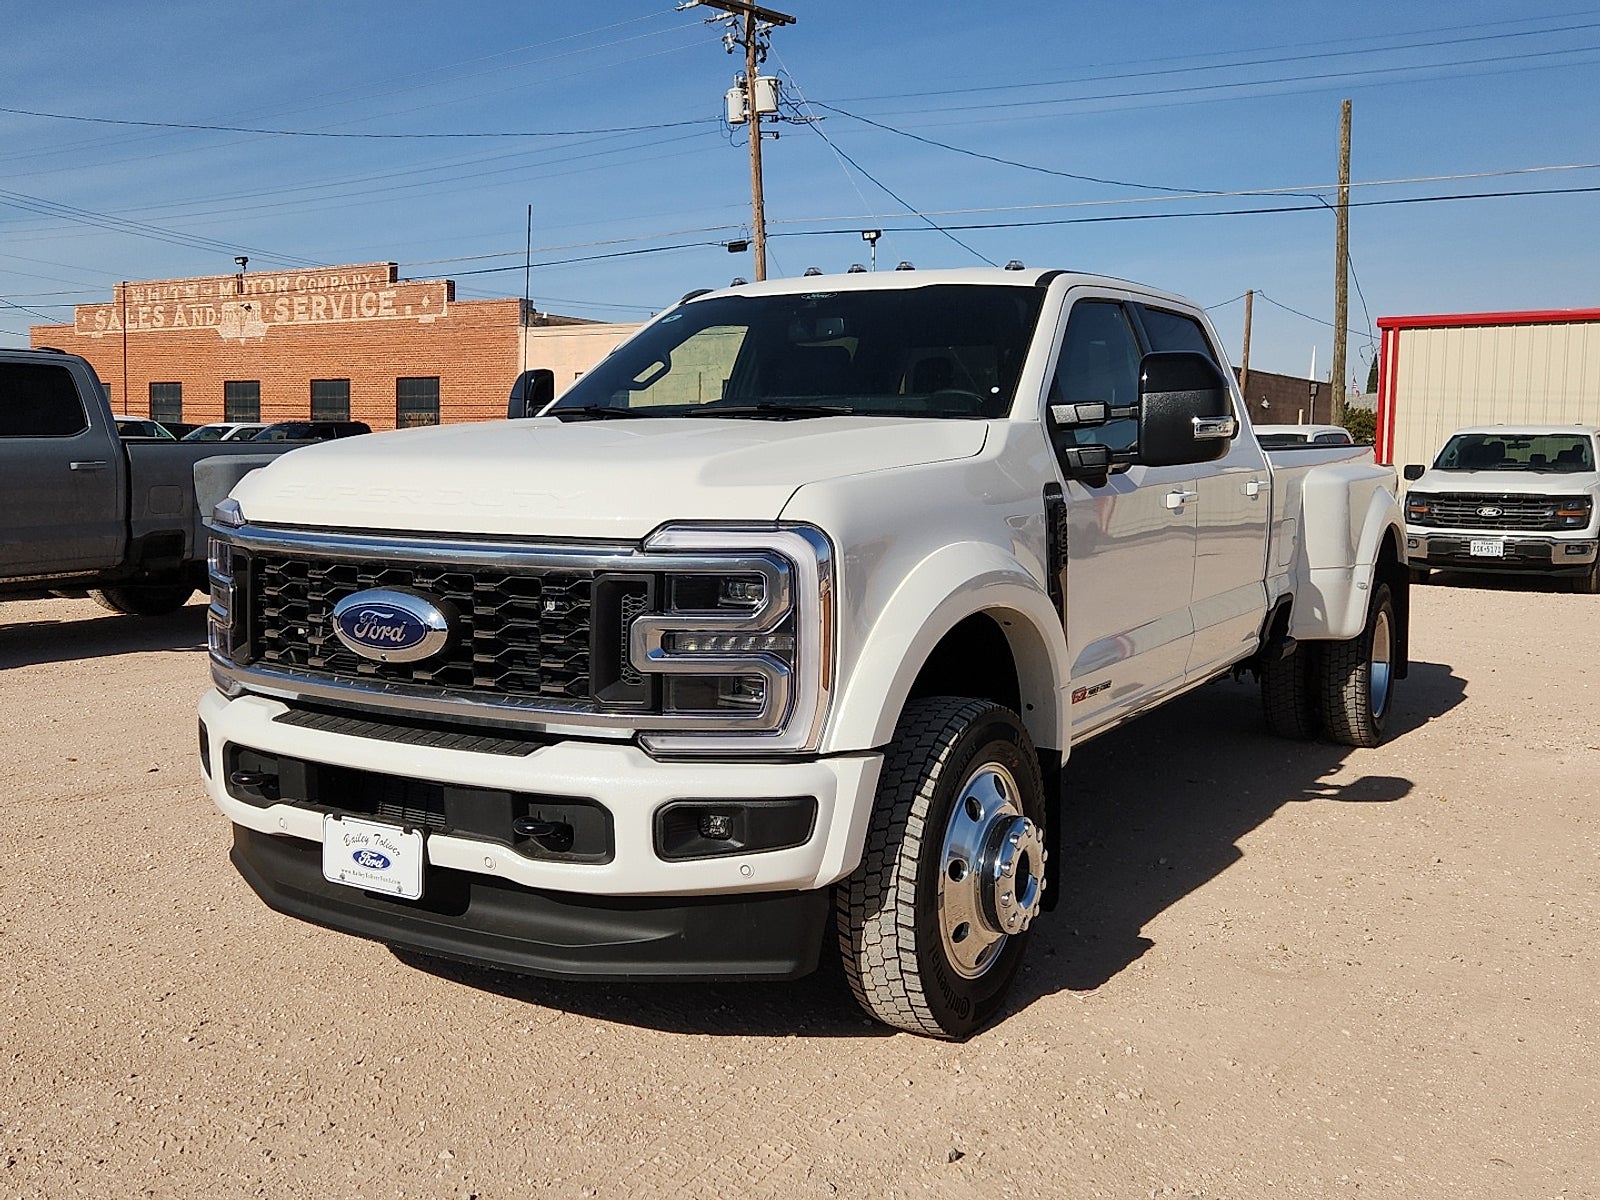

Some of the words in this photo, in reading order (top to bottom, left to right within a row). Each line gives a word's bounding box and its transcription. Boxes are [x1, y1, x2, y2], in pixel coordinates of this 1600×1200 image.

[295, 271, 375, 294] COMPANY
[95, 305, 166, 330] SALES
[172, 304, 217, 327] AND
[273, 290, 397, 323] SERVICE
[354, 609, 407, 643] Ford
[373, 833, 401, 857] Toliver
[357, 850, 386, 869] Ford
